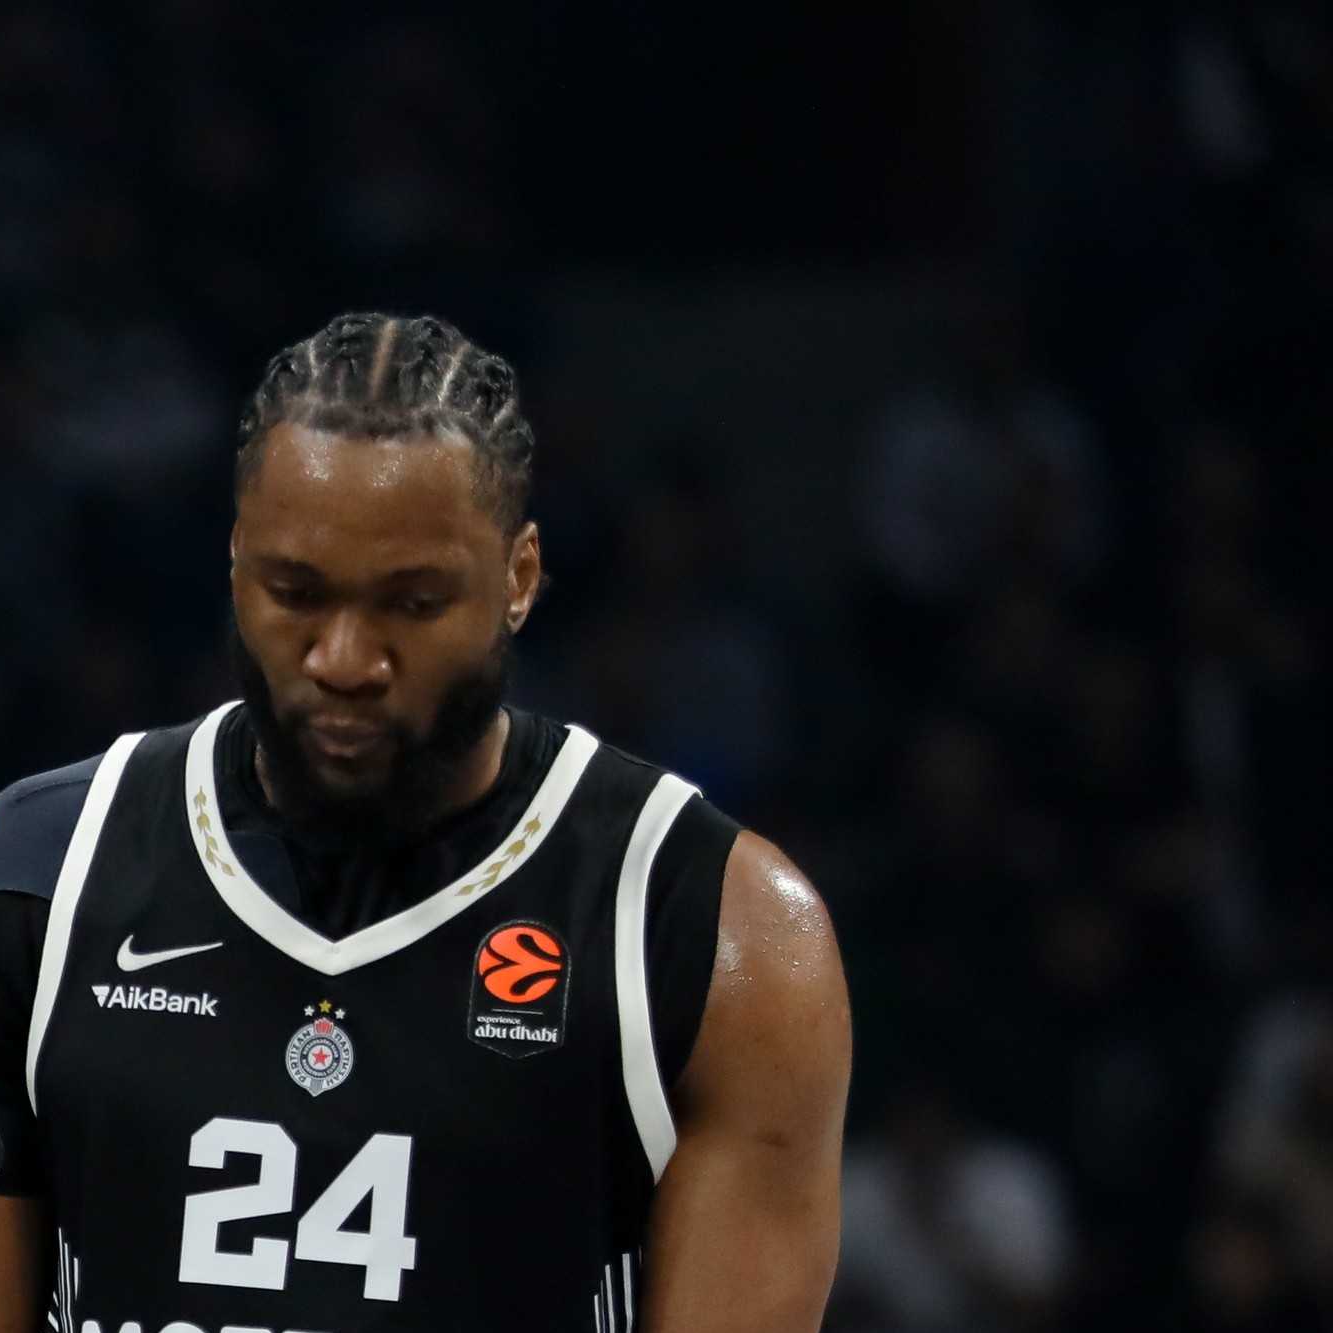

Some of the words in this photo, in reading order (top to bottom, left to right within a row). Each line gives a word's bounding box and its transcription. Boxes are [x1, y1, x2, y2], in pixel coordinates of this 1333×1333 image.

[106, 985, 219, 1017] AikBank
[476, 1015, 522, 1025] experience
[474, 1024, 507, 1039] abu
[509, 1025, 558, 1043] dhabi
[178, 1116, 417, 1302] 24
